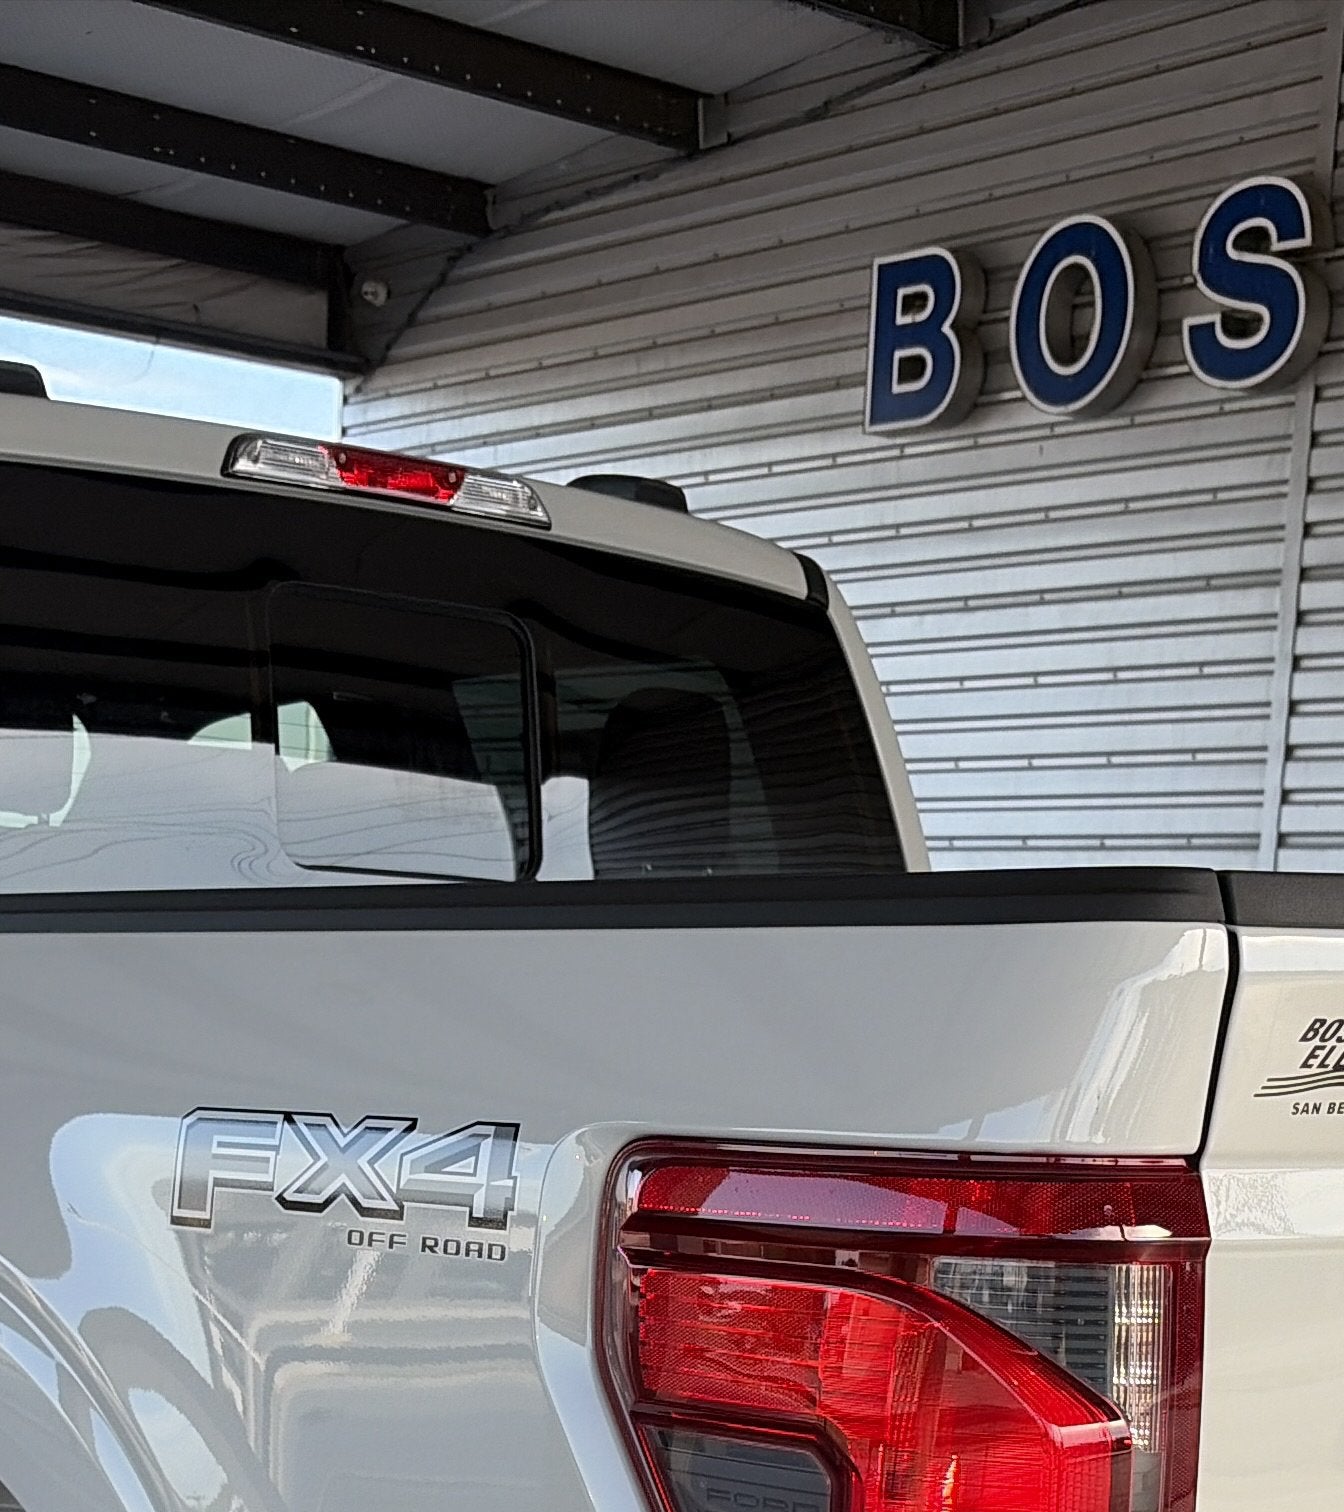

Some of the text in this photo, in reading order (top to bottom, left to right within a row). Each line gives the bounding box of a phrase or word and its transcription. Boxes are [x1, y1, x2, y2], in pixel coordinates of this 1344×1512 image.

[1290, 1101, 1321, 1115] SAN
[170, 1106, 521, 1231] FX4
[346, 1228, 507, 1263] OFF ROAD
